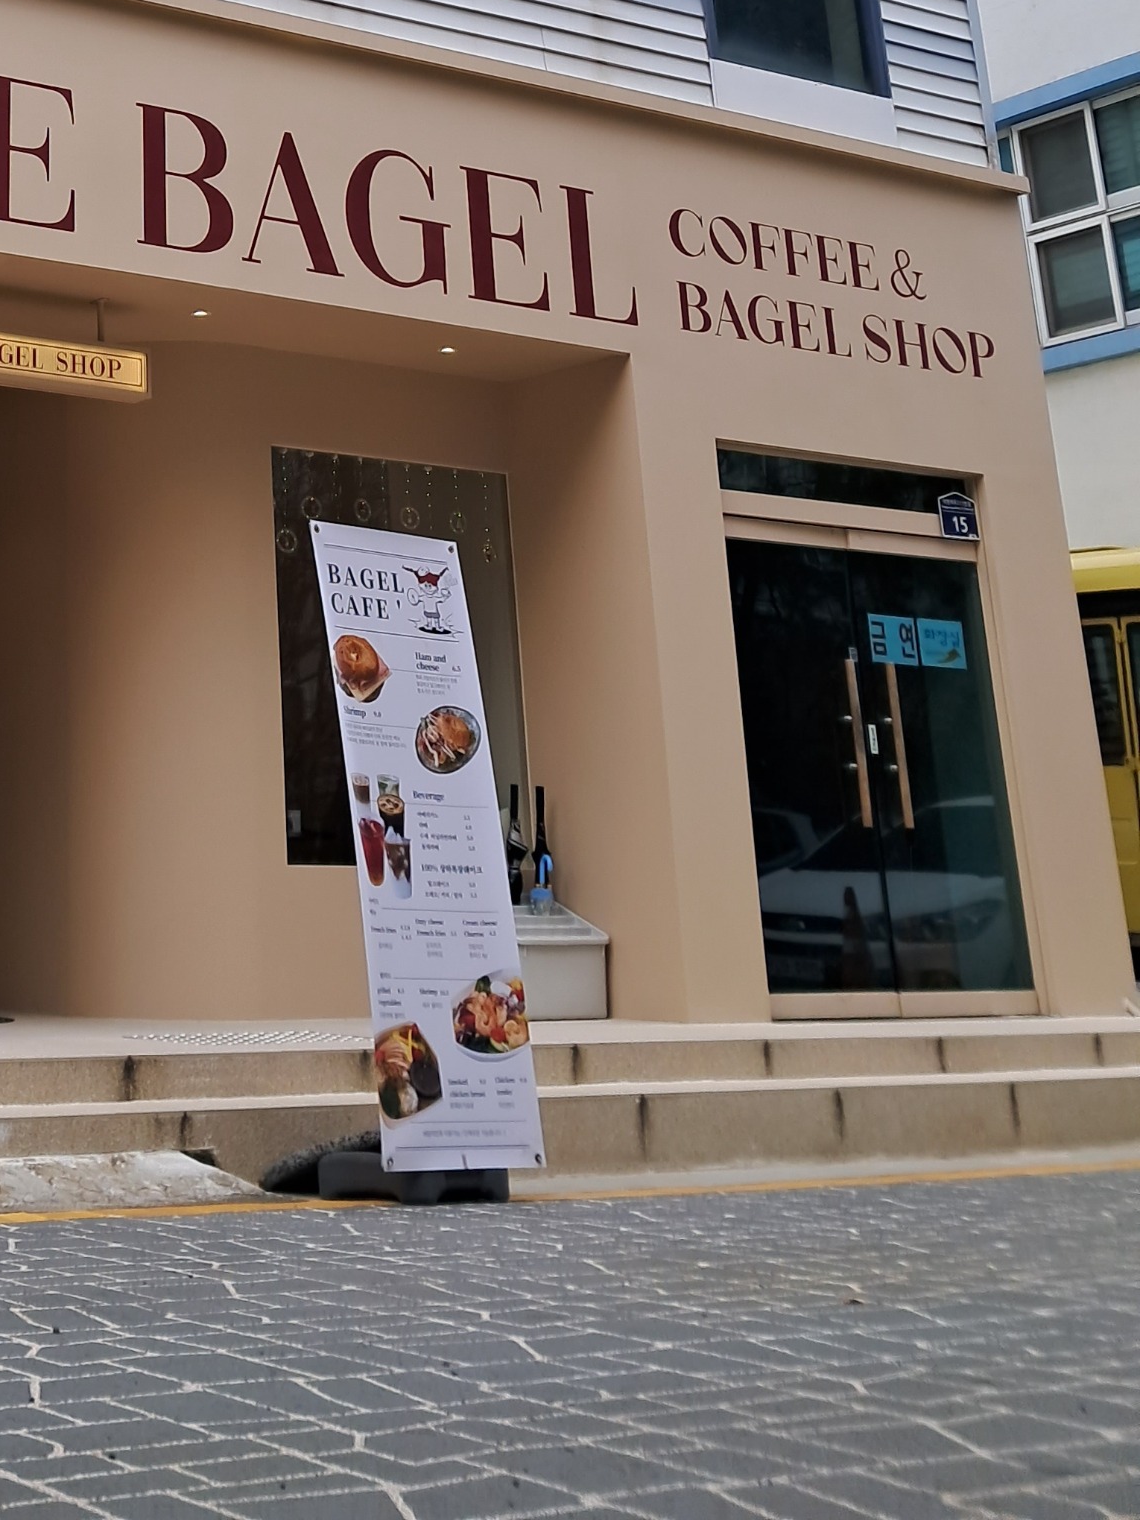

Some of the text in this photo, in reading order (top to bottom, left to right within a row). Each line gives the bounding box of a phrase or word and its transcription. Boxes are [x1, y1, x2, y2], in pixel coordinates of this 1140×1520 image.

[136, 102, 639, 327] BAGEL
[668, 207, 928, 301] COFFEE &
[676, 280, 996, 379] BAGEL SHOP
[56, 351, 122, 379] SHOP
[952, 515, 969, 533] 15
[326, 562, 406, 594] BAGEL
[923, 628, 961, 649] 화장실
[414, 651, 447, 663] Ham and
[416, 661, 440, 672] cheese
[413, 790, 445, 802] Beverage
